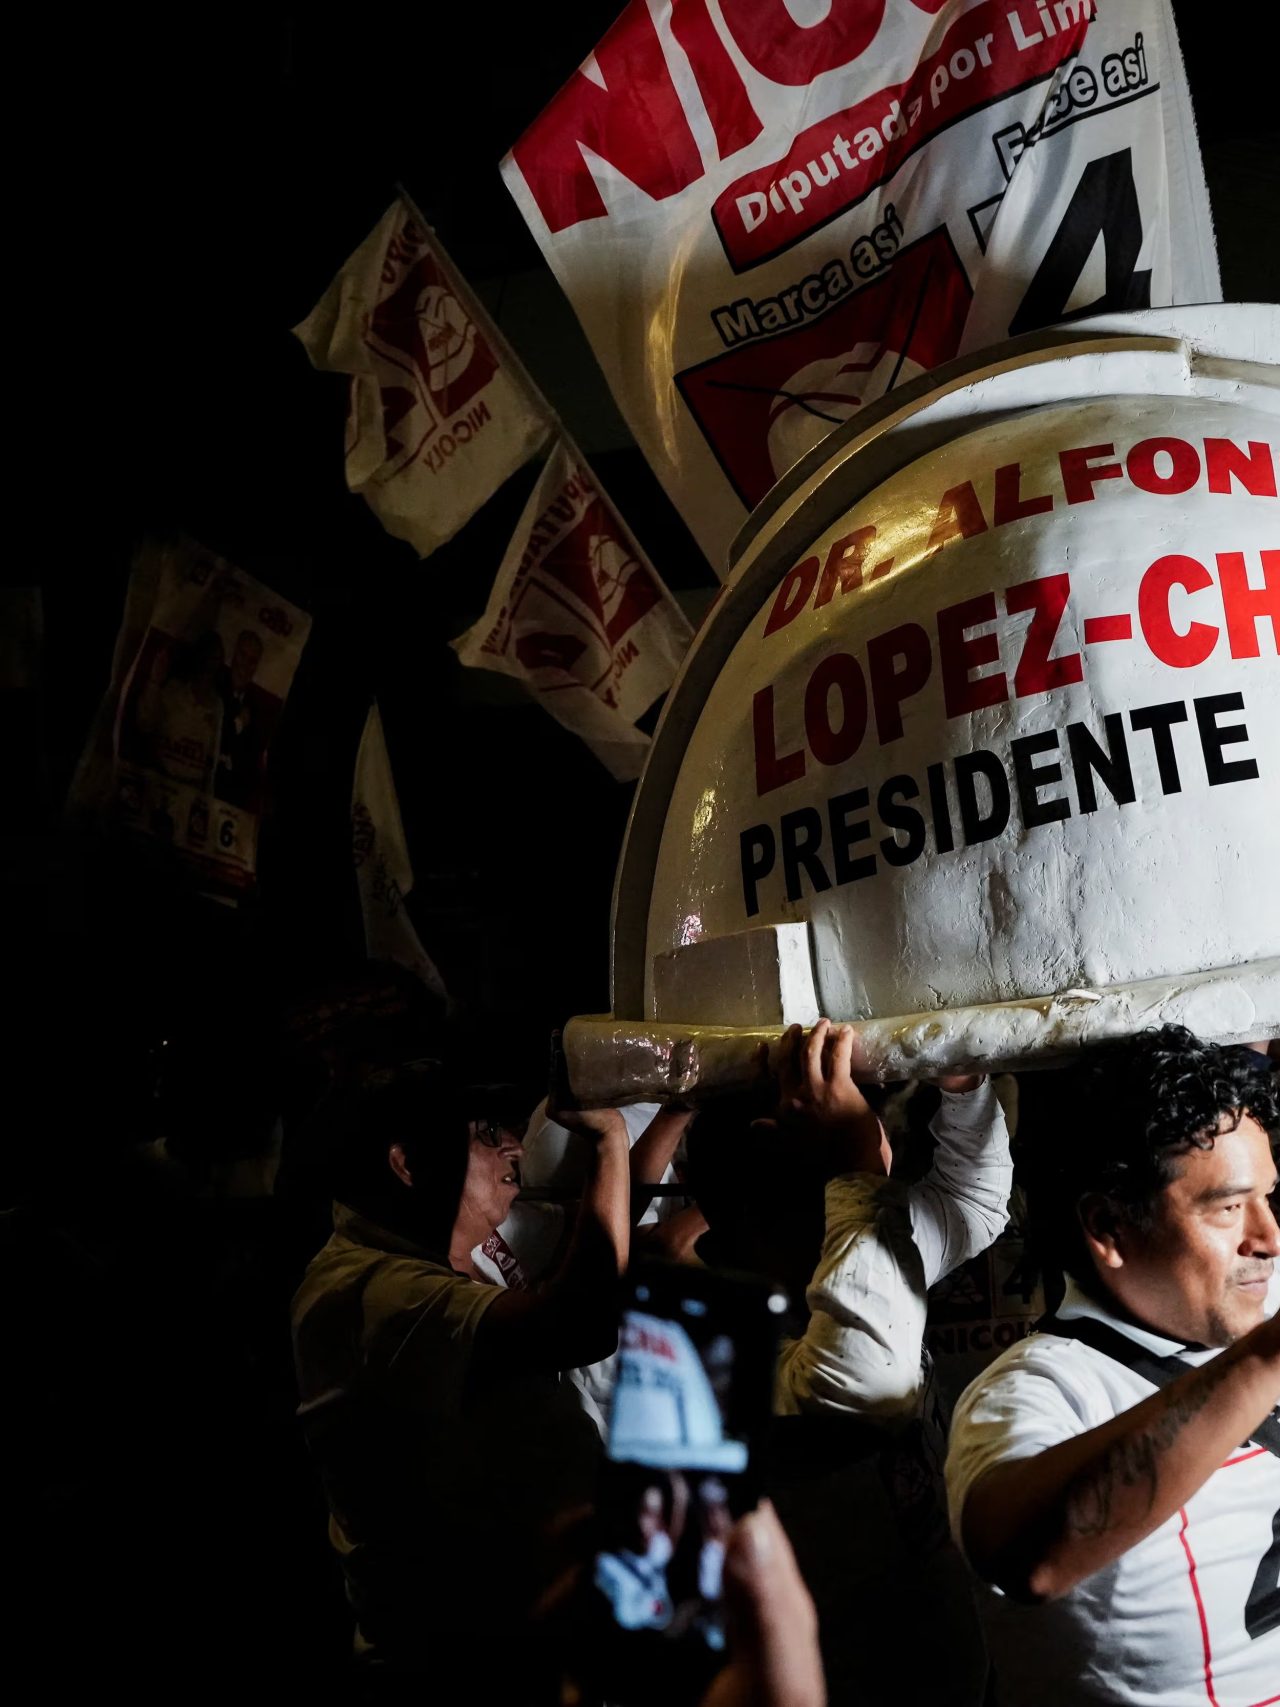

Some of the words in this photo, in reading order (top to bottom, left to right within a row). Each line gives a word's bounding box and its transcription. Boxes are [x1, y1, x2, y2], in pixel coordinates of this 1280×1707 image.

[735, 95, 923, 234] Diputada
[930, 32, 994, 110] por
[1007, 0, 1093, 51] Lim
[1101, 31, 1150, 98] así
[709, 257, 853, 348] Marca
[850, 203, 906, 288] así
[1006, 147, 1153, 337] 4
[763, 523, 897, 638] DR.
[738, 691, 1261, 917] PRESIDENTE
